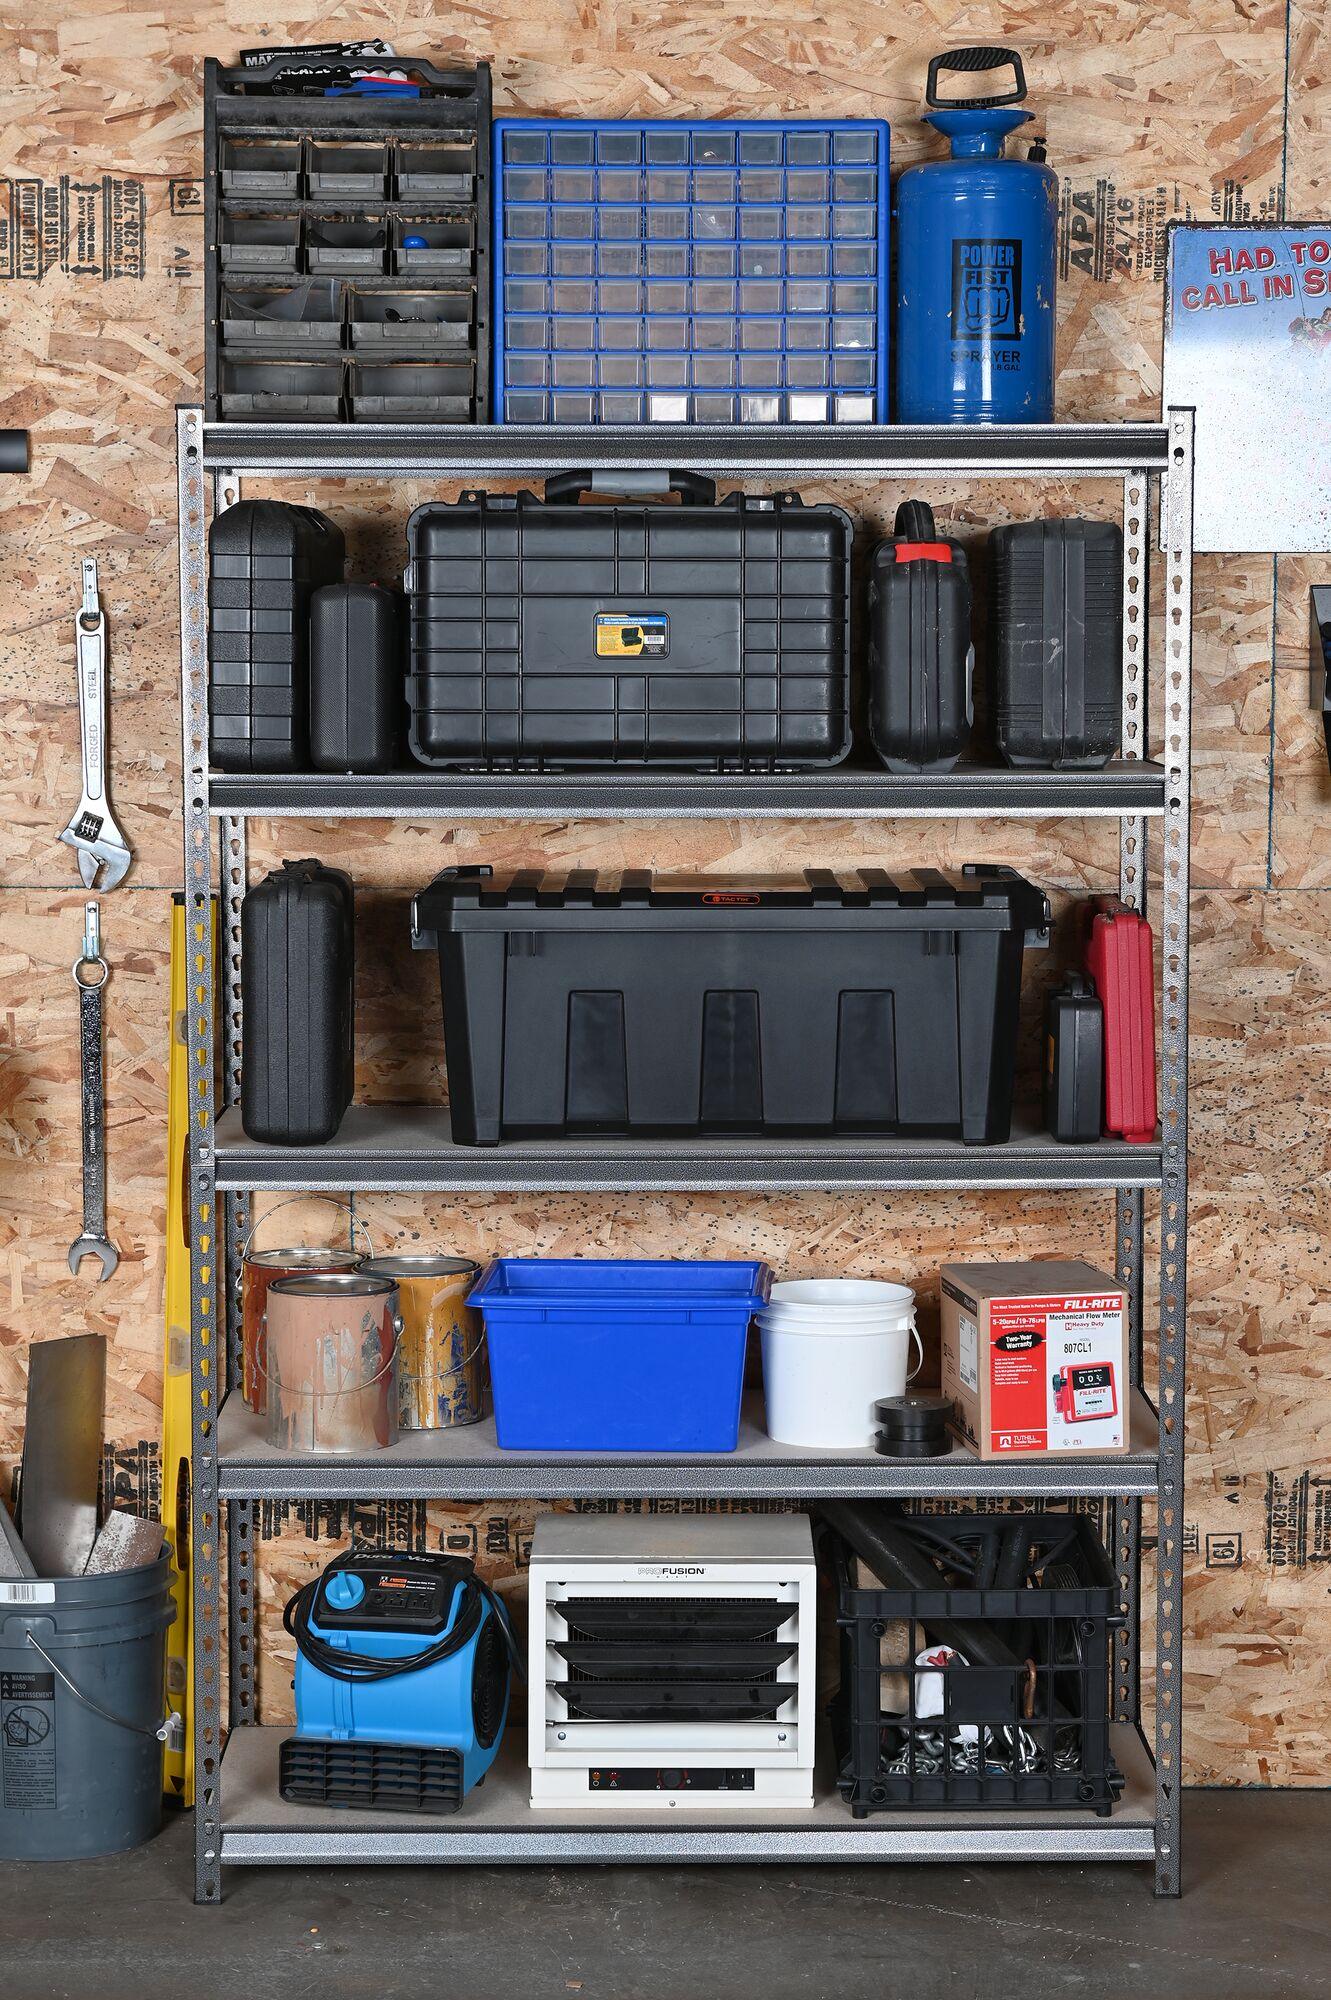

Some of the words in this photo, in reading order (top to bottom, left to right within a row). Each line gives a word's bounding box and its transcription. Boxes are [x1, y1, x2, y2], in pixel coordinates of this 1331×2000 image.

[22, 186, 36, 226] CANADA
[45, 187, 58, 218] DOWN
[113, 180, 123, 219] SUPPORT
[45, 221, 58, 244] SIDE
[113, 222, 123, 261] PRODUCT
[1071, 190, 1095, 275] APA
[1116, 198, 1136, 269] 24/16
[960, 245, 1015, 266] POWER
[1208, 246, 1277, 277] HAD
[1289, 239, 1331, 267] TO
[965, 270, 1010, 285] FIST
[1181, 280, 1258, 312] CALL
[1263, 274, 1295, 300] IN
[88, 668, 96, 699] STEEL
[89, 725, 98, 768] FORGED
[1063, 1298, 1120, 1310] FILL-RITE
[1005, 1333, 1032, 1343] Two-Year
[1006, 1340, 1033, 1350] Warranty
[1063, 1342, 1092, 1354] 807CL1
[1213, 1540, 1234, 1559] 19
[638, 1567, 705, 1575] PROFUSION
[12, 1691, 53, 1699] AVERTISSEMENT
